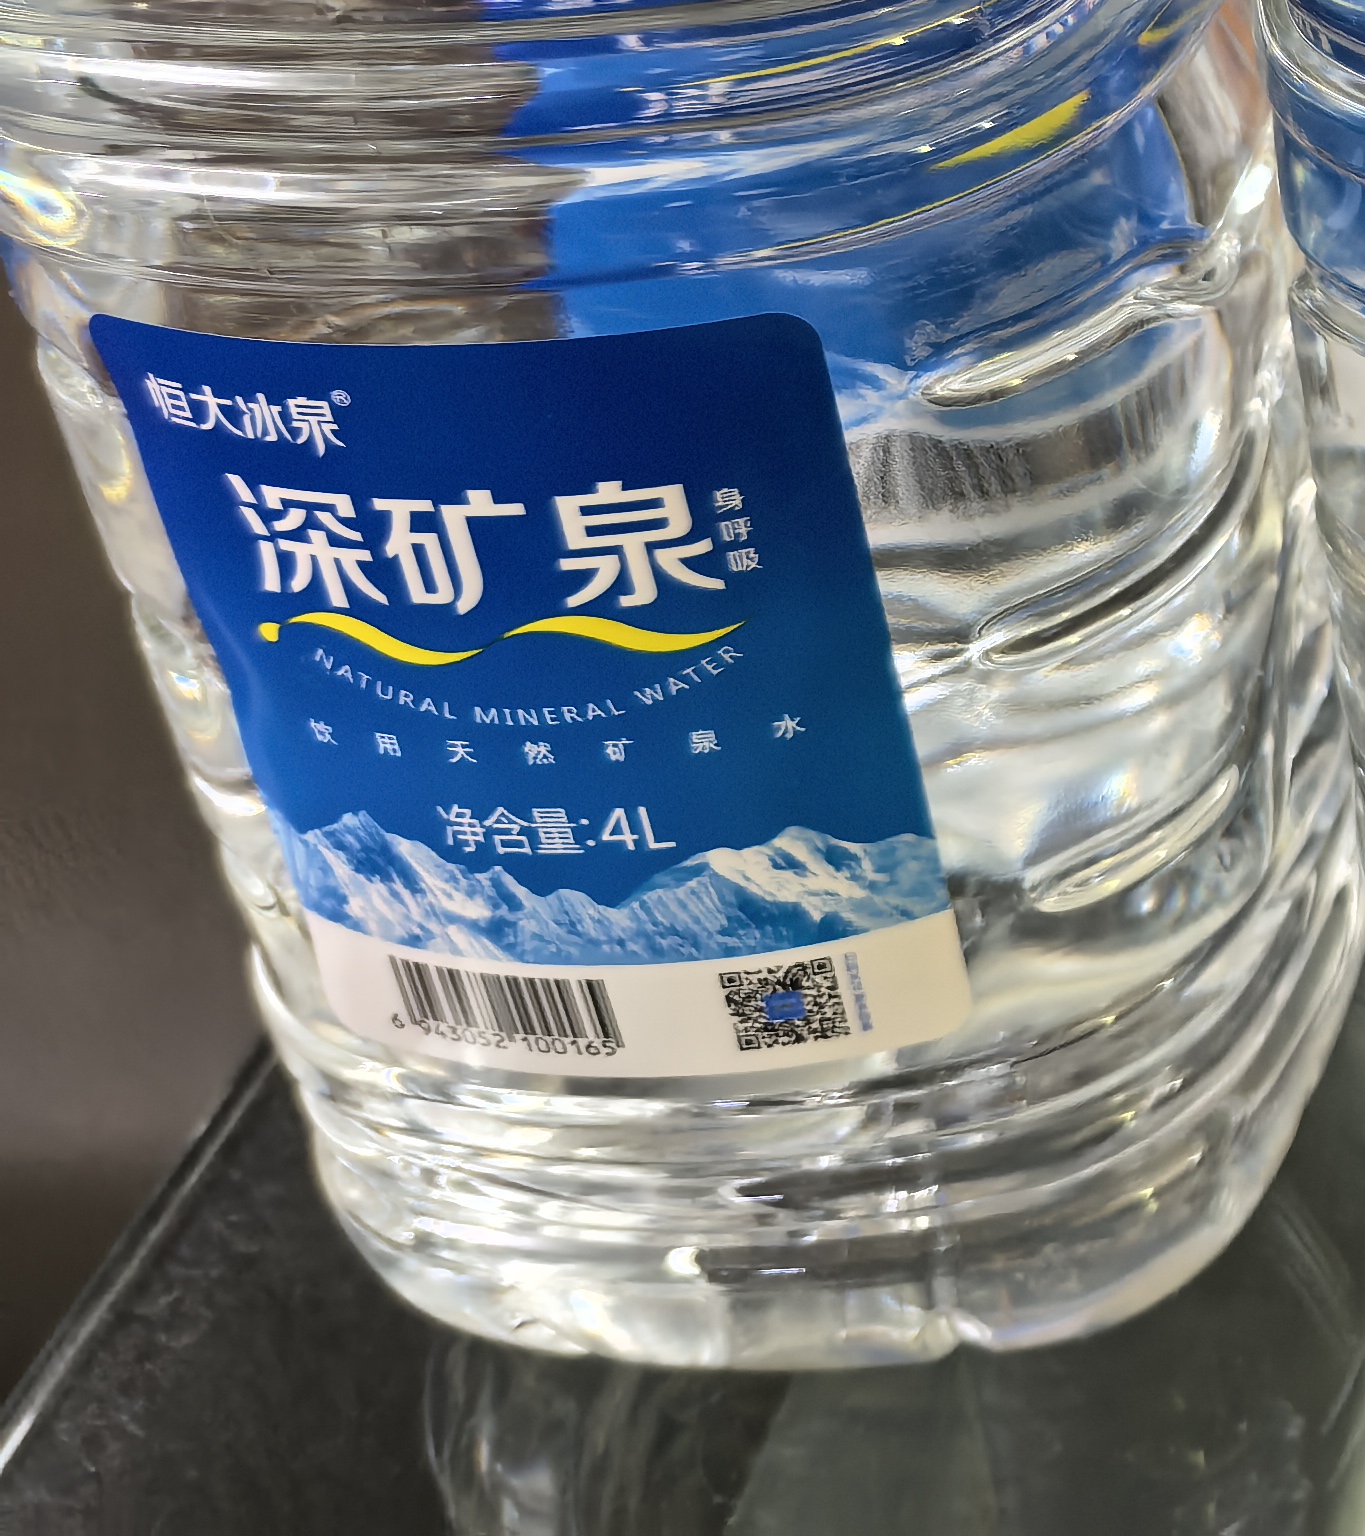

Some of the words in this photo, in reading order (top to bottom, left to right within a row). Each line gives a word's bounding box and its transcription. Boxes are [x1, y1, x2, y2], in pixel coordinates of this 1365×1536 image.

[145, 371, 346, 457] 恒大冰泉
[226, 471, 727, 615] 深矿泉
[713, 487, 763, 573] 身呼吸
[313, 647, 458, 720] NATURAL
[473, 699, 627, 726] MINERAL
[633, 644, 744, 706] WATER
